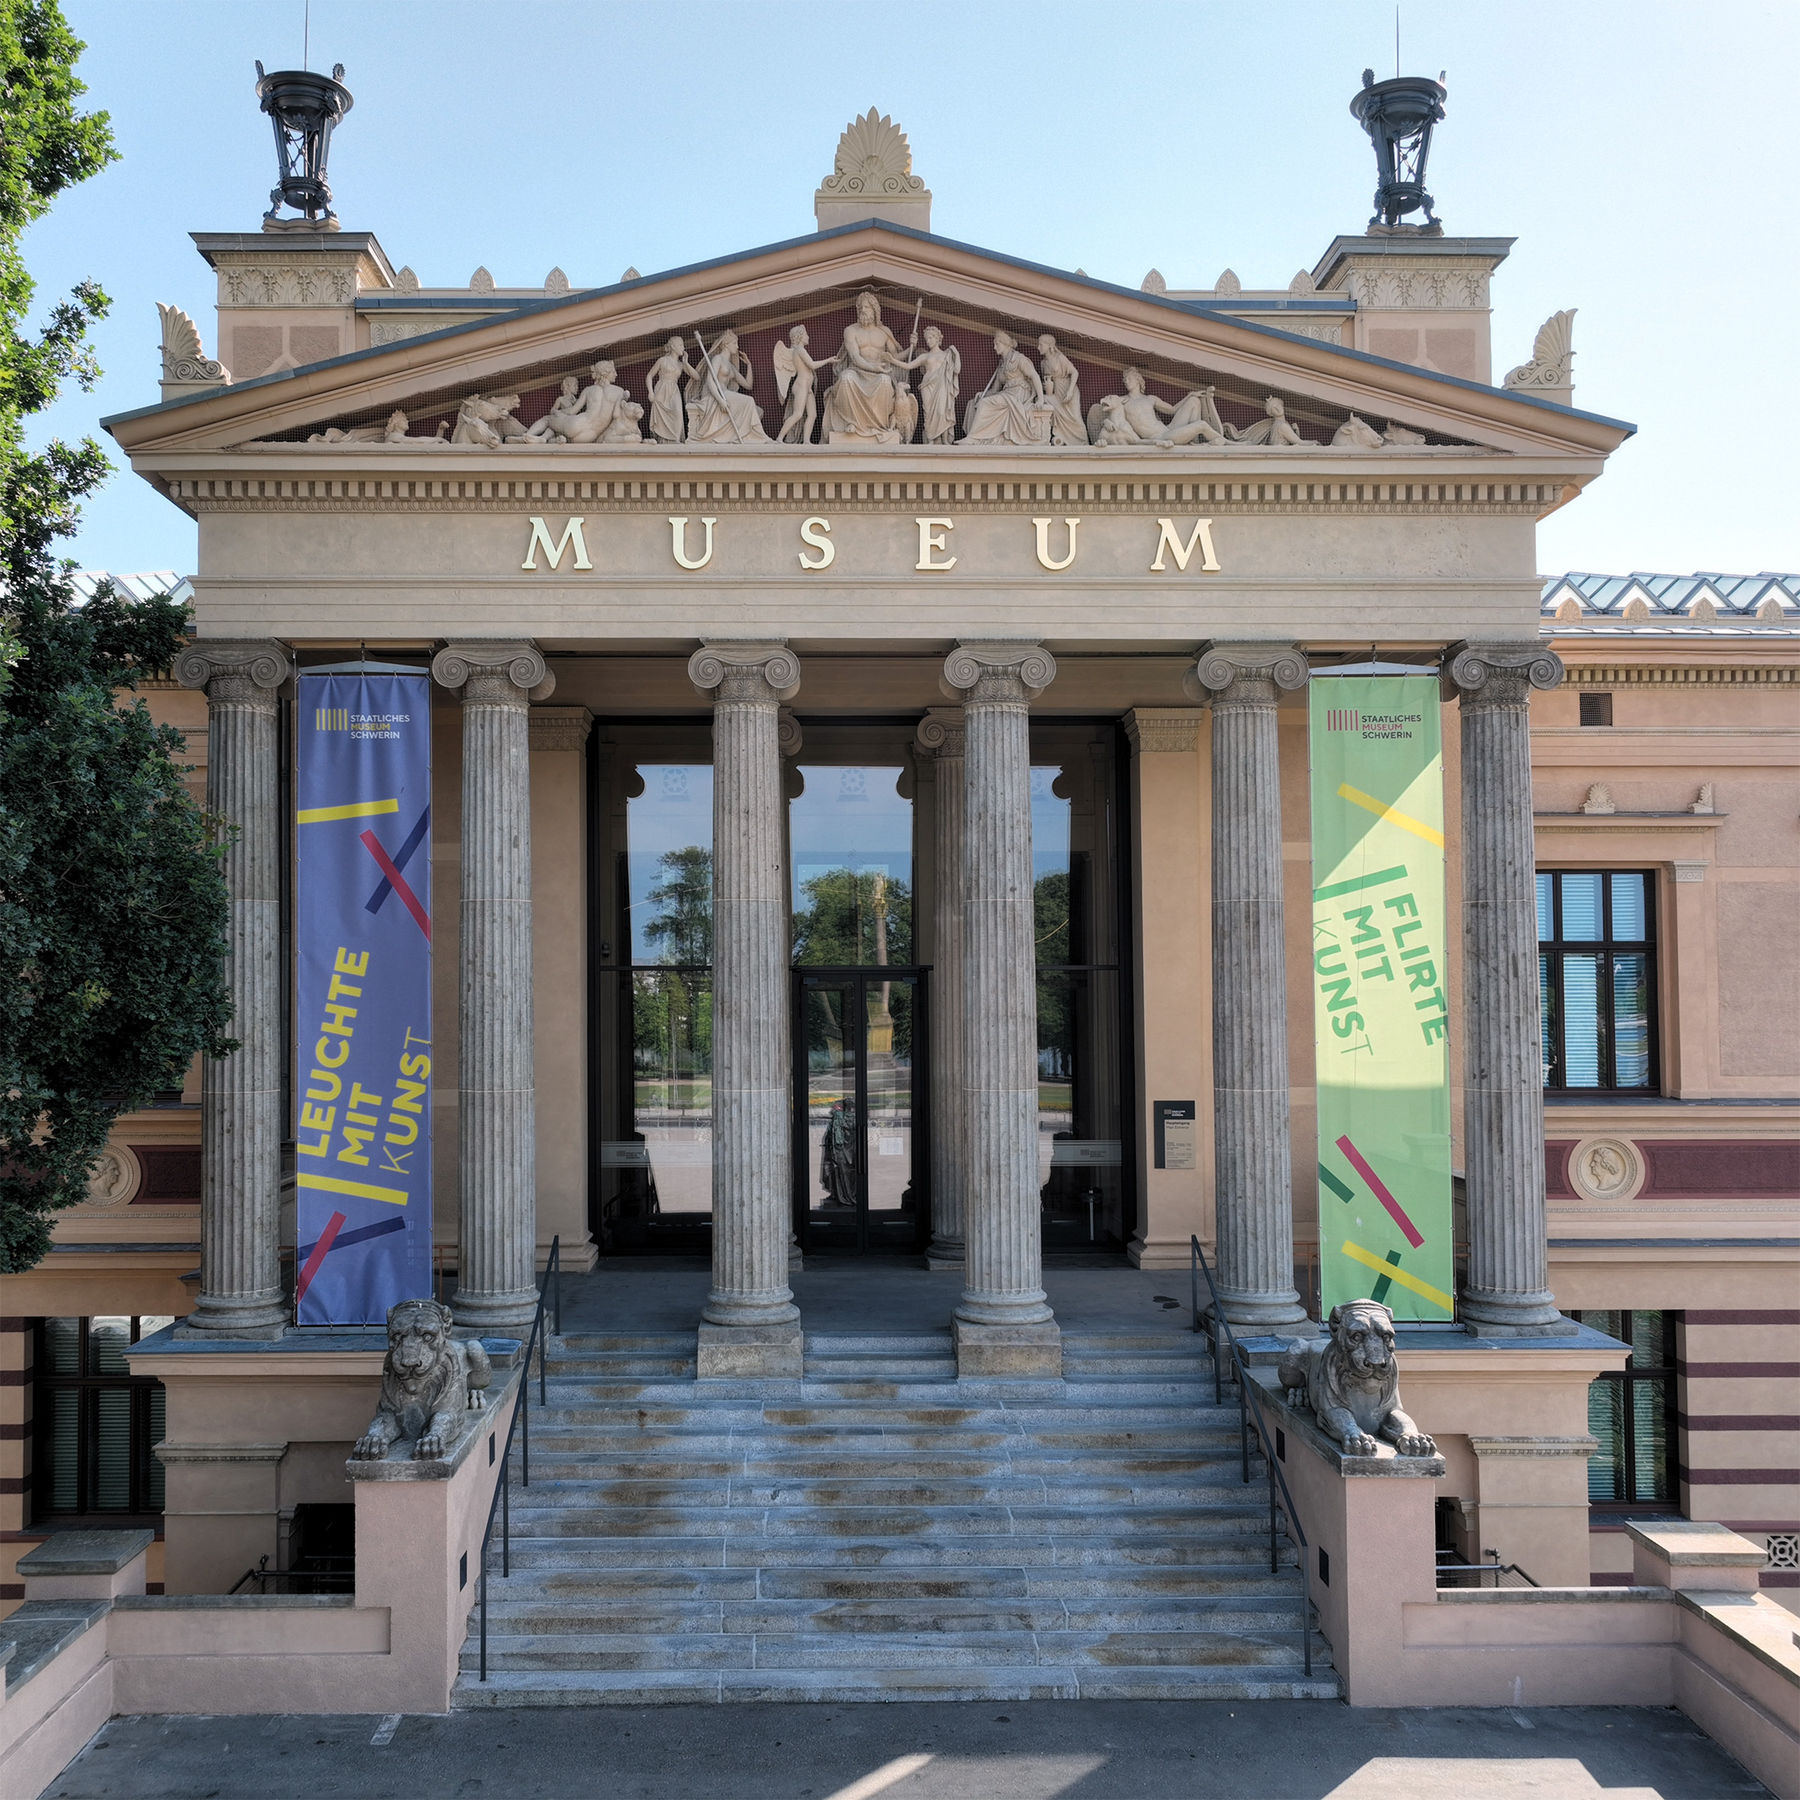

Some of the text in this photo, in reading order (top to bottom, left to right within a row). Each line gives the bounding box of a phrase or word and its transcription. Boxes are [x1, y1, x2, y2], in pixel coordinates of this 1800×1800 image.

[521, 516, 1221, 571] MUSEUM
[350, 714, 410, 723] STAATLICHES
[350, 723, 391, 731] MUSEUM
[350, 731, 400, 739] SCHWERIN
[1361, 714, 1422, 723] STAATLICHES
[1362, 723, 1403, 731] MUSEUM
[1362, 731, 1413, 739] SCHWERIN
[1343, 904, 1395, 982] MIT
[1383, 892, 1449, 1046] FLIRTE
[1313, 917, 1374, 1056] KUNST
[297, 946, 370, 1158] LEUCHTE
[336, 1081, 383, 1167] MIT
[379, 1025, 431, 1175] KUNST
